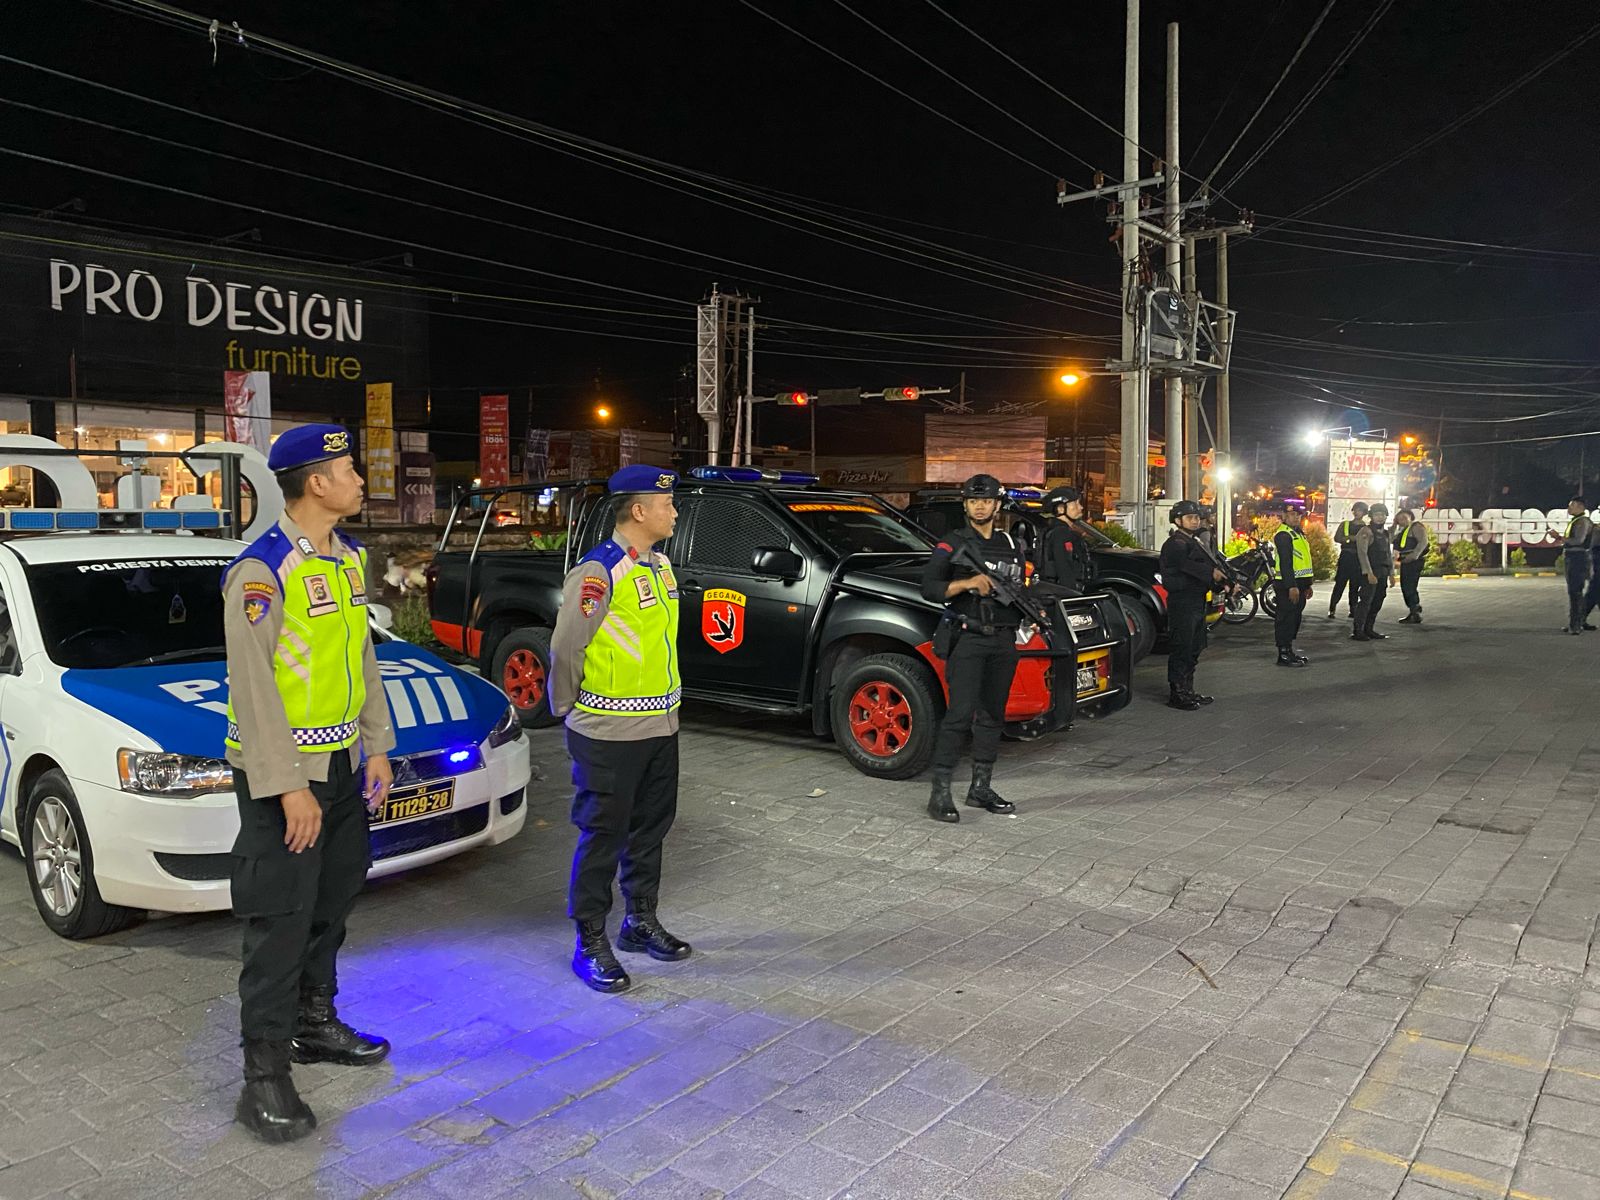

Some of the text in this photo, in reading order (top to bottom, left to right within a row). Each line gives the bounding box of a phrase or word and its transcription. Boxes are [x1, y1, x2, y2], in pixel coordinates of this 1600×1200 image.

[50, 257, 363, 342] PRO DESIGN
[226, 340, 362, 380] furniture
[838, 470, 868, 483] Pizza
[419, 483, 433, 495] IN
[76, 559, 234, 574] POLRESTA DENPA
[706, 591, 742, 602] GEGANA
[390, 791, 449, 819] 11129-28
